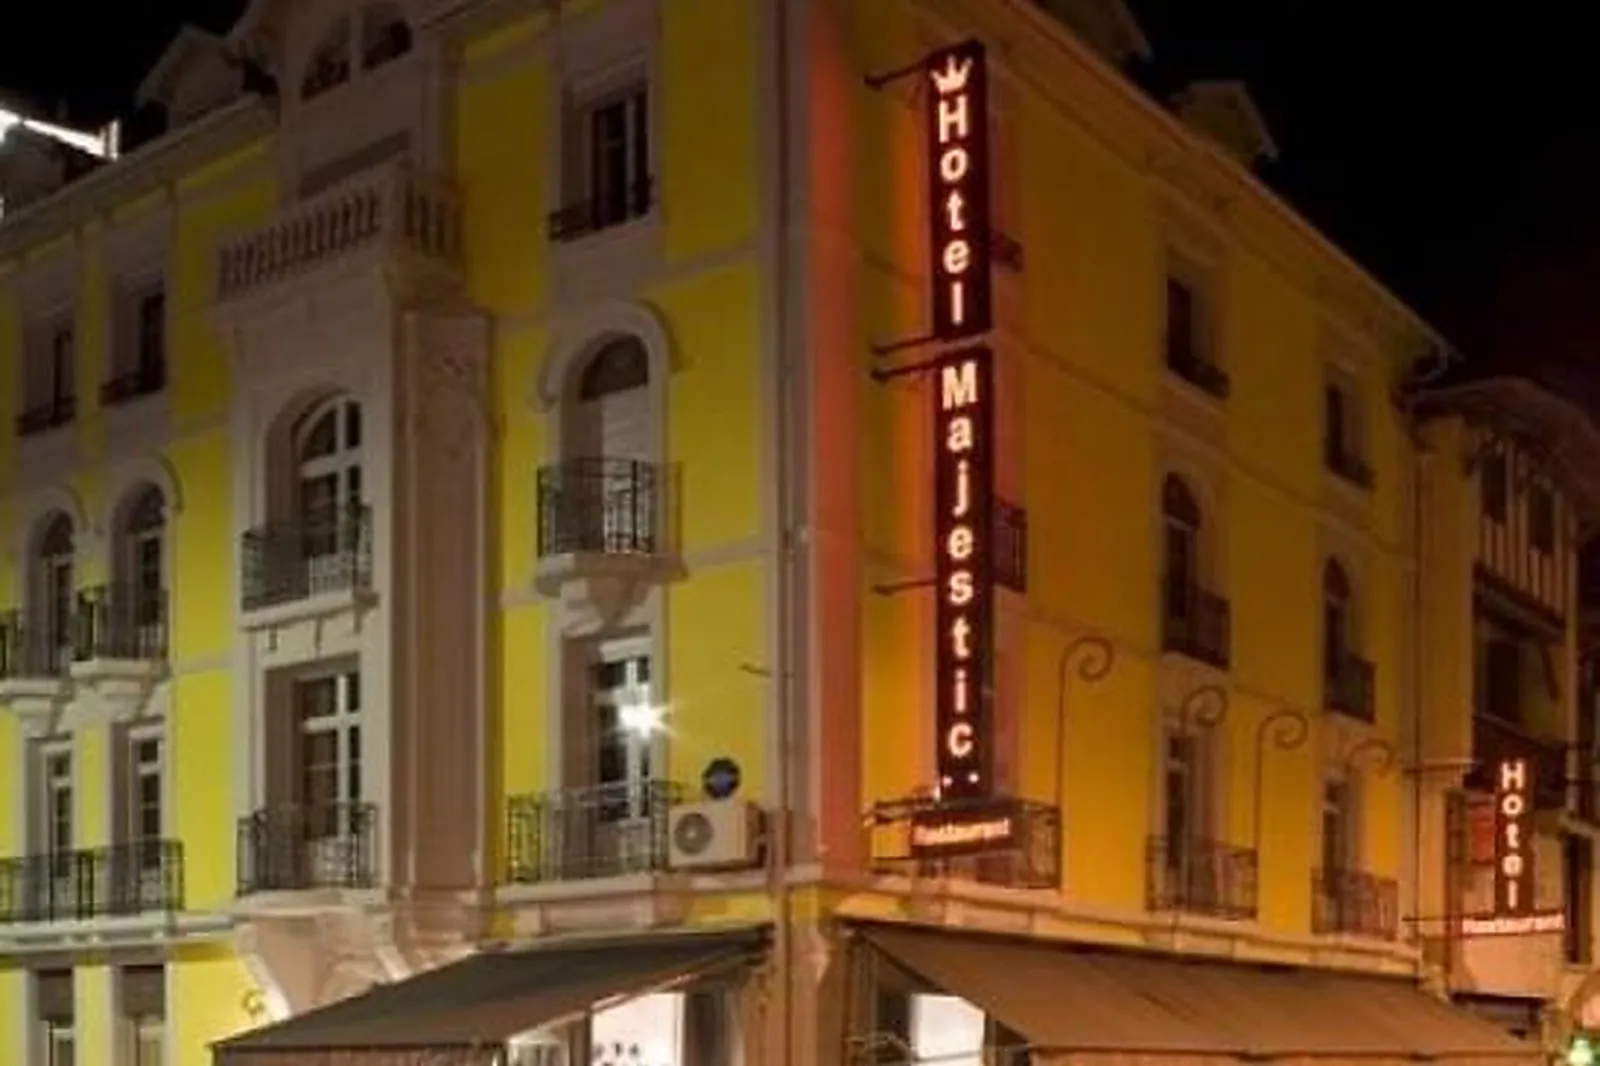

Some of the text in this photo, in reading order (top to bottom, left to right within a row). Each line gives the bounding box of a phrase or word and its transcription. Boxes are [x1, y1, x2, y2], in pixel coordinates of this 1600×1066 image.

[938, 95, 978, 757] Hotel Majestic
[1501, 761, 1524, 909] Hotel
